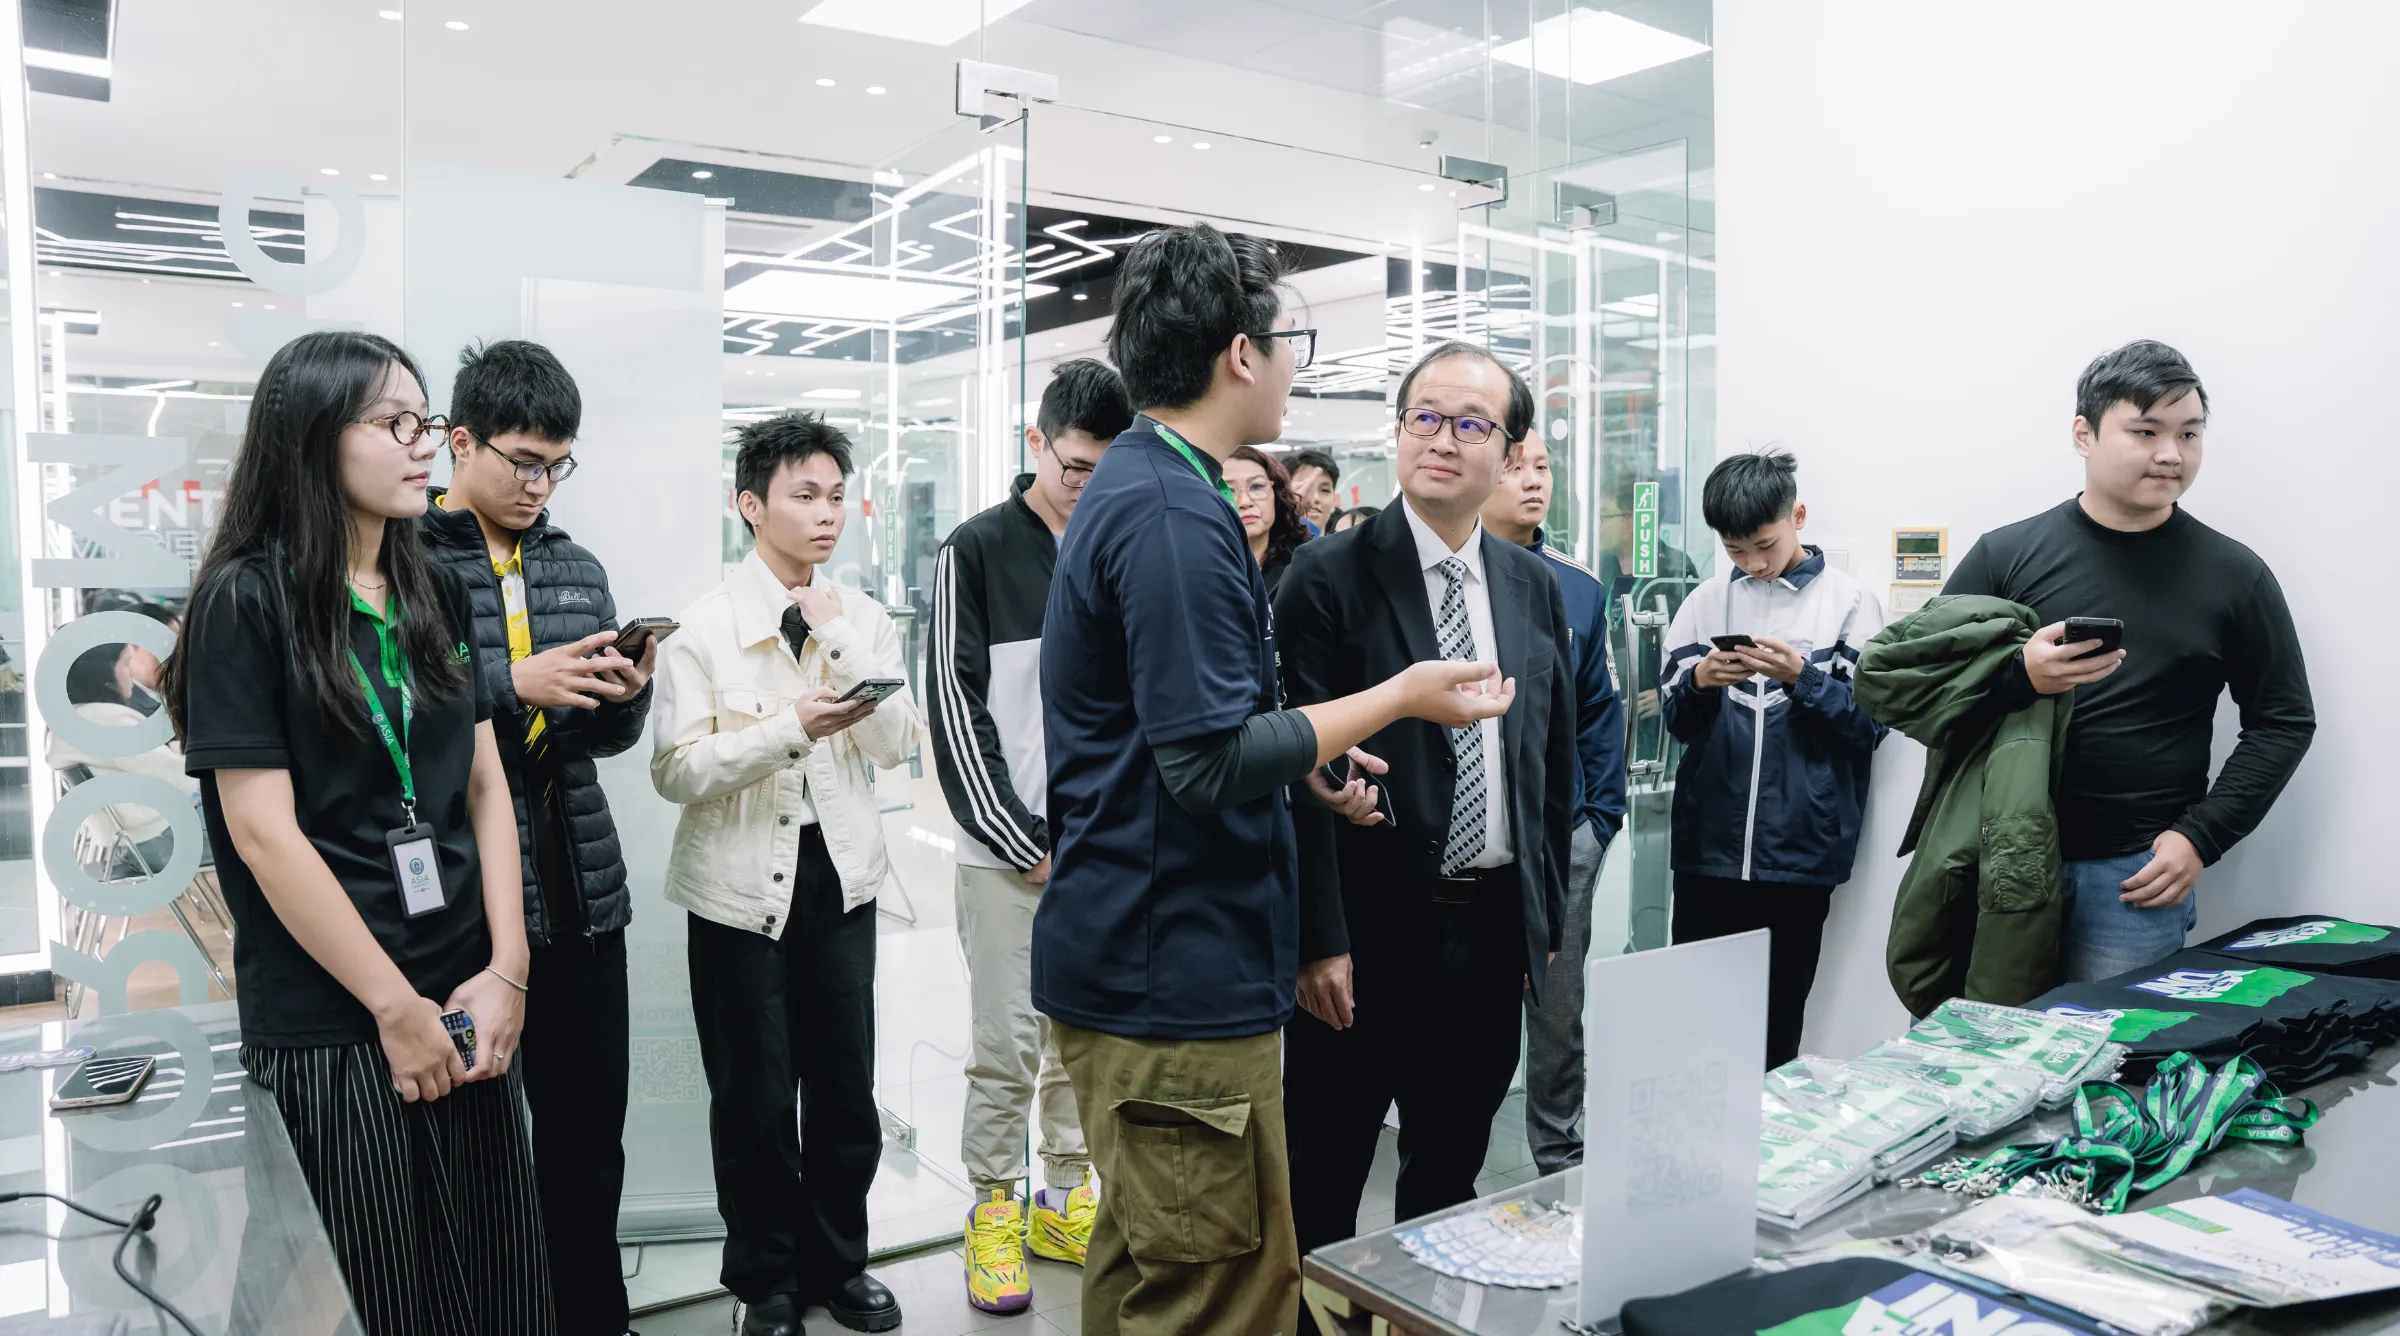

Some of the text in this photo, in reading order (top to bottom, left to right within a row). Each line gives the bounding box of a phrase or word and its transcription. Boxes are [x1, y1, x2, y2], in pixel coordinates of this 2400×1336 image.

[1639, 513, 1651, 573] PUSH
[380, 724, 395, 746] ASIA
[411, 874, 430, 885] ASIA
[2247, 1129, 2277, 1138] ASIA
